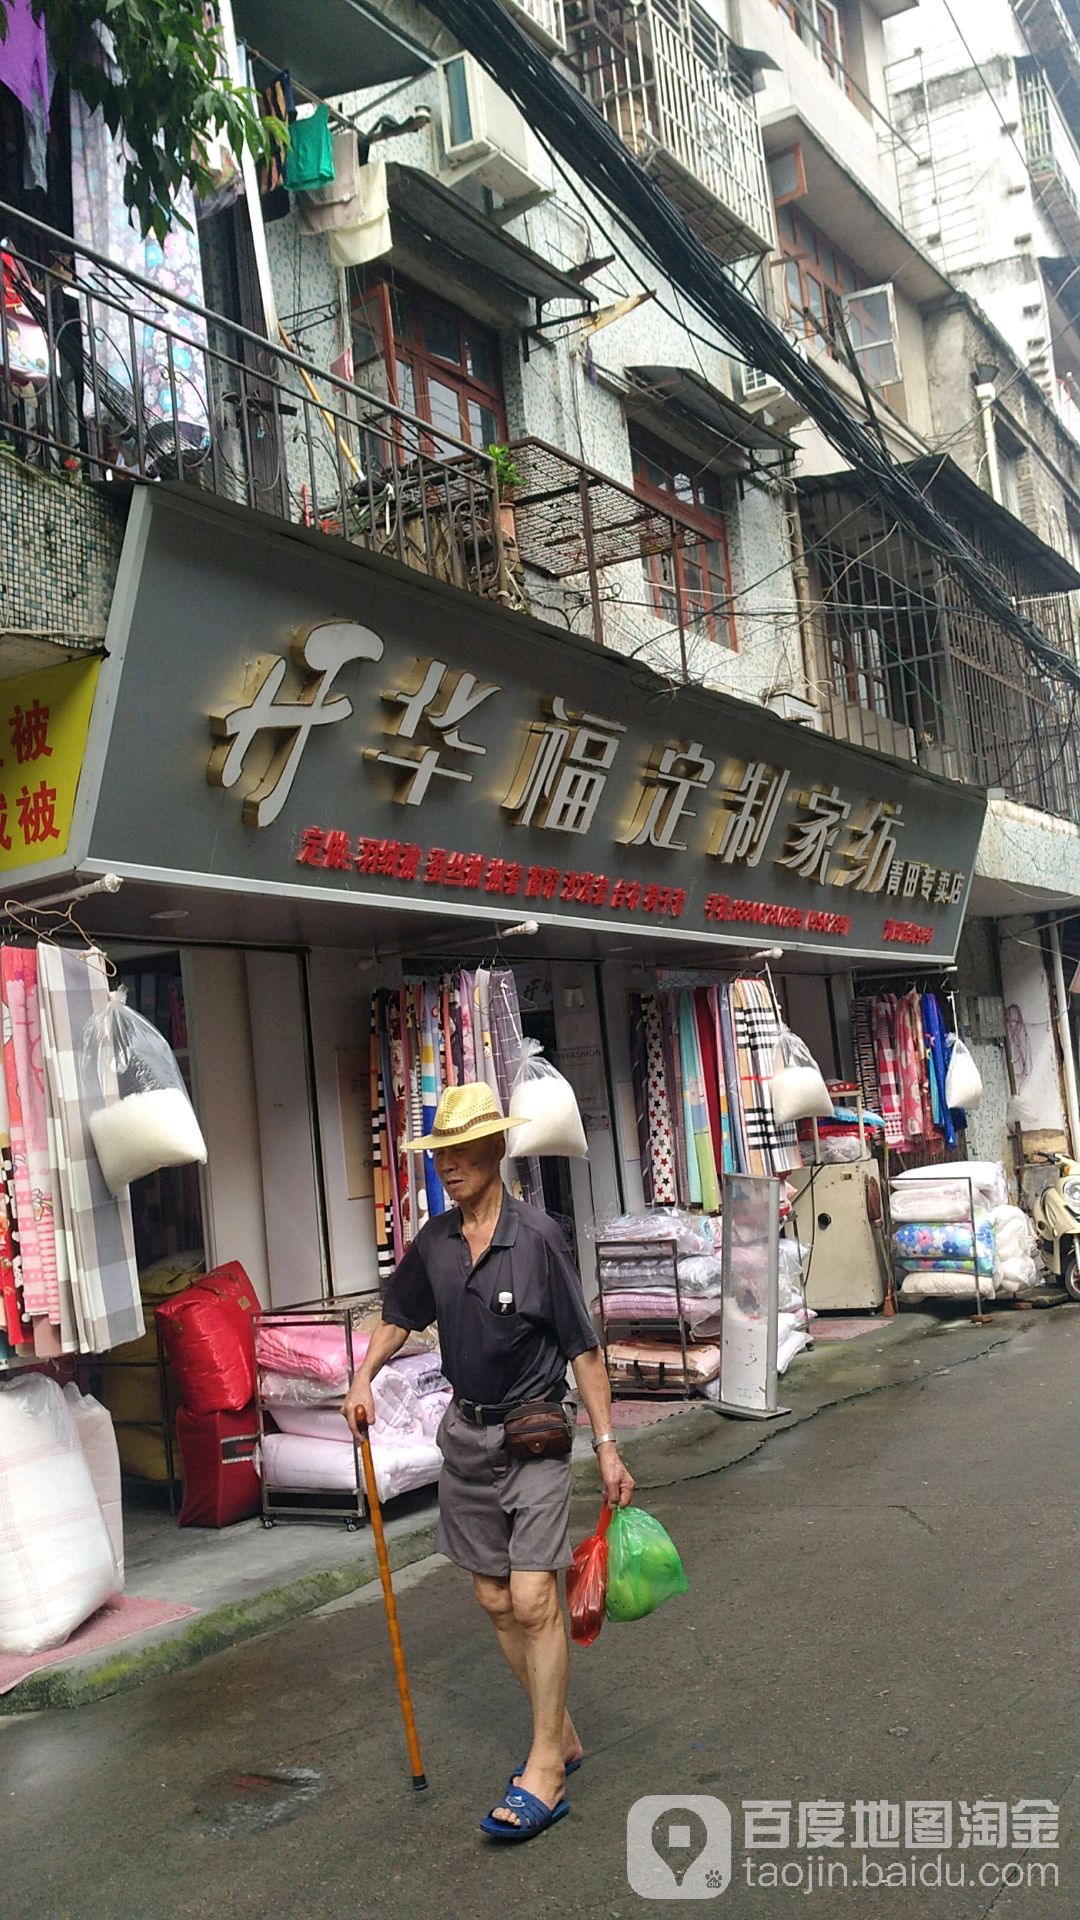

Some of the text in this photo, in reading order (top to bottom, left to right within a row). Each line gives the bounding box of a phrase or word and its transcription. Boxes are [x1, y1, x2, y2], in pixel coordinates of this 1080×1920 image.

[886, 859, 966, 905] 青田专卖店
